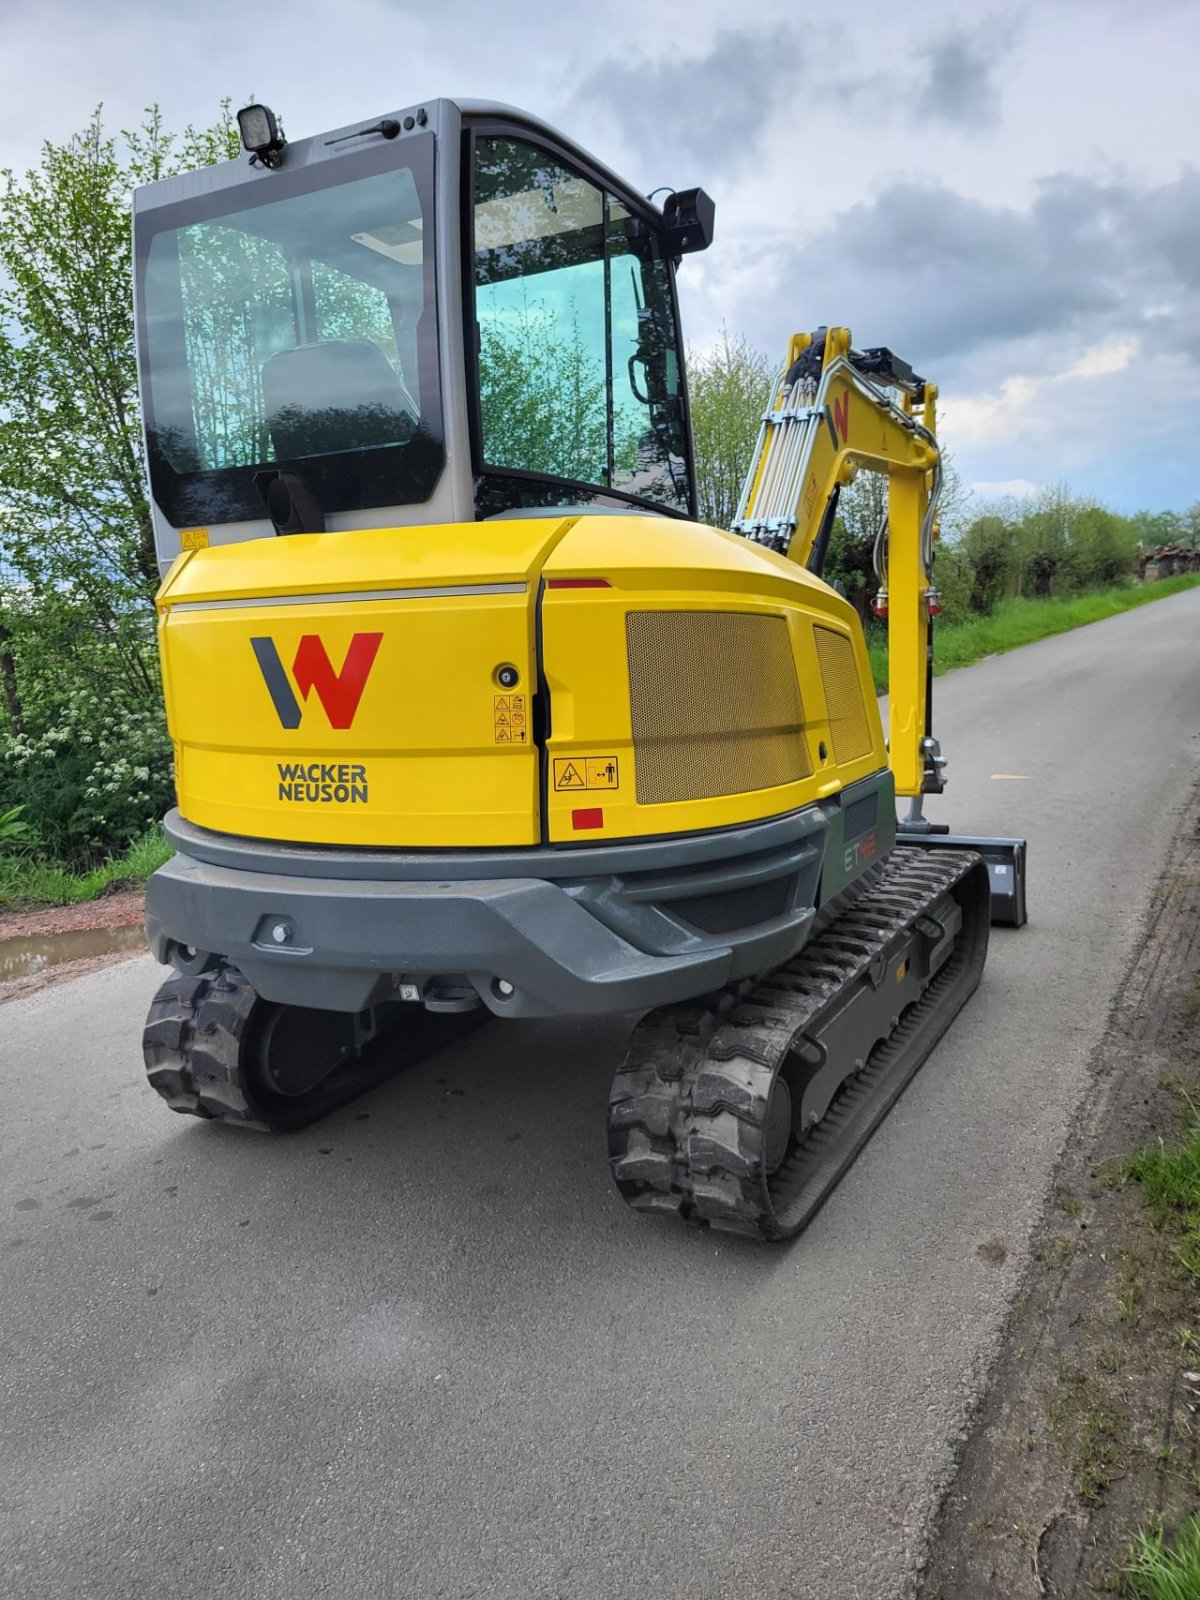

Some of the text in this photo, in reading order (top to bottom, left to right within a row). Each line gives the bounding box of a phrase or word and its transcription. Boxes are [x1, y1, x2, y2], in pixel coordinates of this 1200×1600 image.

[249, 632, 384, 729] W
[277, 763, 368, 783] WACKER
[278, 783, 368, 803] NEUSON
